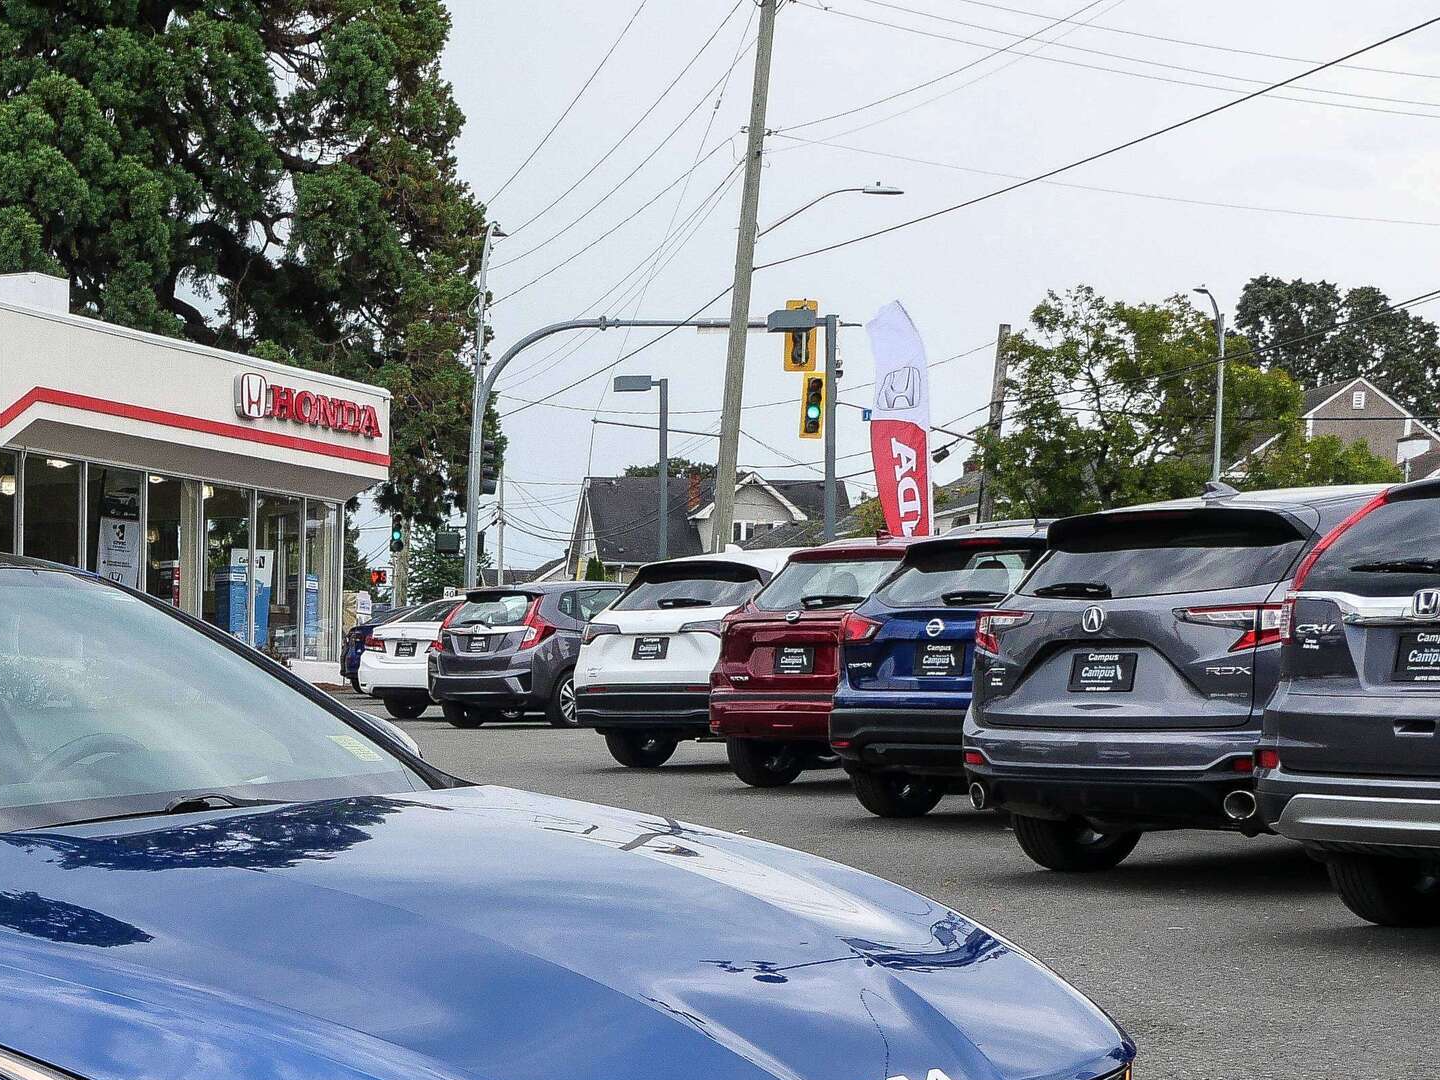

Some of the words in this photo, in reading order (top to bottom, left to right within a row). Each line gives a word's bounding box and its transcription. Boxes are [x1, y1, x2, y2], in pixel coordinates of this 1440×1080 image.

[270, 384, 383, 438] HONDA
[1088, 653, 1120, 663] Campus
[1081, 666, 1116, 680] Campus
[1206, 666, 1251, 676] RDX
